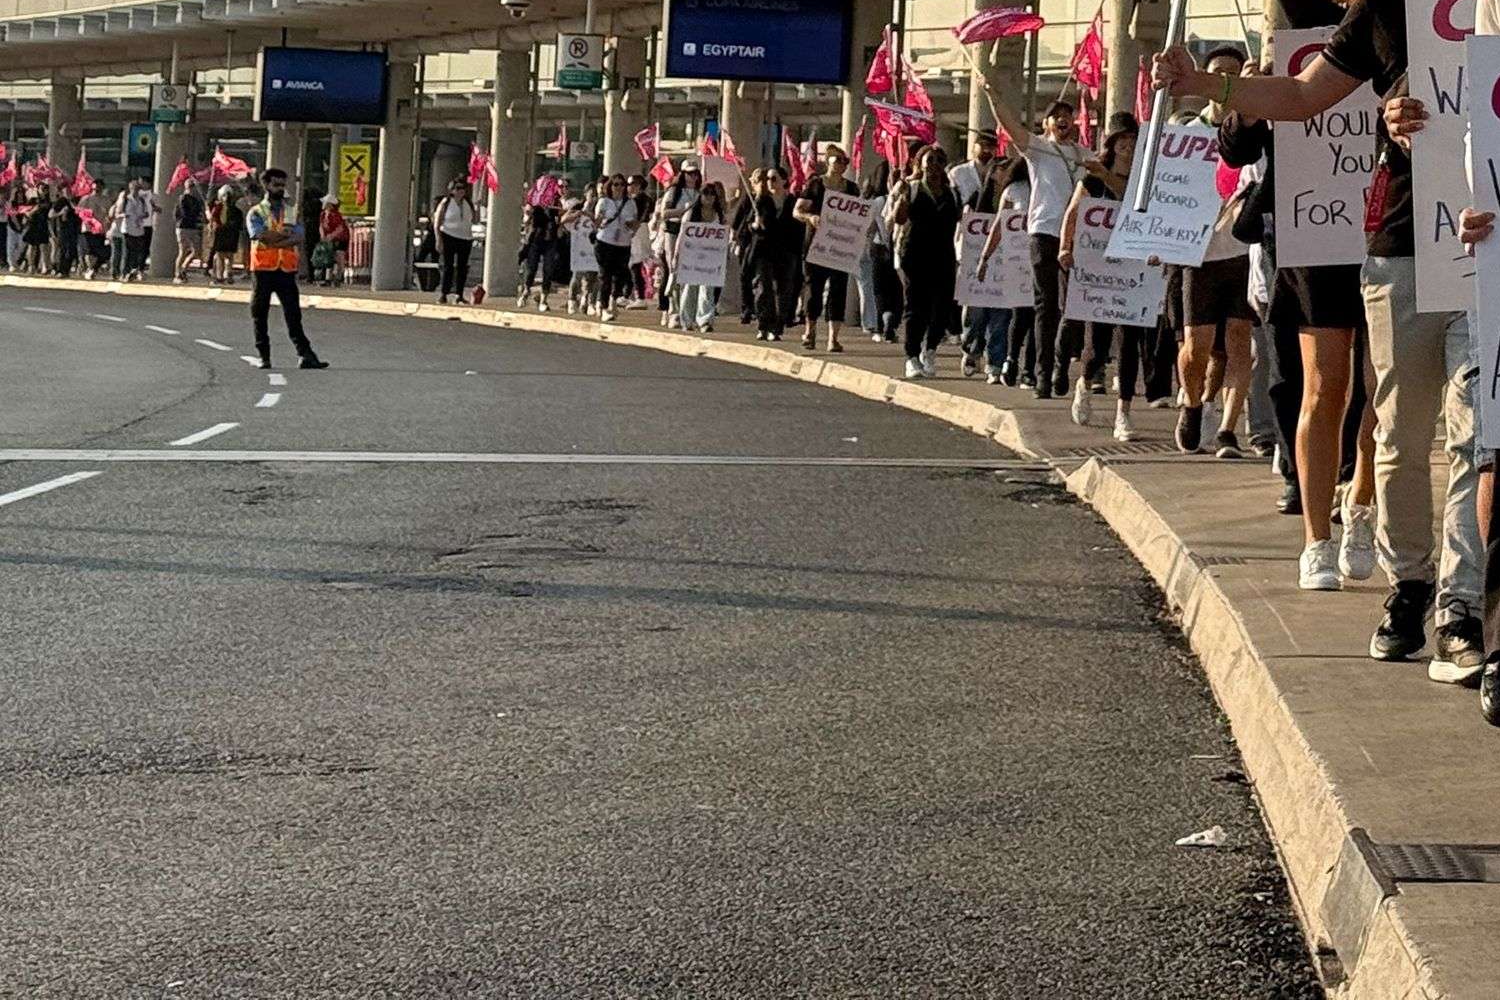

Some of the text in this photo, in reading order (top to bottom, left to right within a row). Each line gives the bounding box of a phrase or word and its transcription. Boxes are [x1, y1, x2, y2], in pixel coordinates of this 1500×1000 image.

[702, 44, 765, 58] EGYPTAIR
[285, 81, 324, 90] AVIANCA
[1304, 110, 1375, 138] WOUL
[1161, 132, 1219, 162] UPE
[827, 196, 871, 217] CUPE
[1294, 189, 1352, 229] FOR
[685, 225, 726, 239] CUPE
